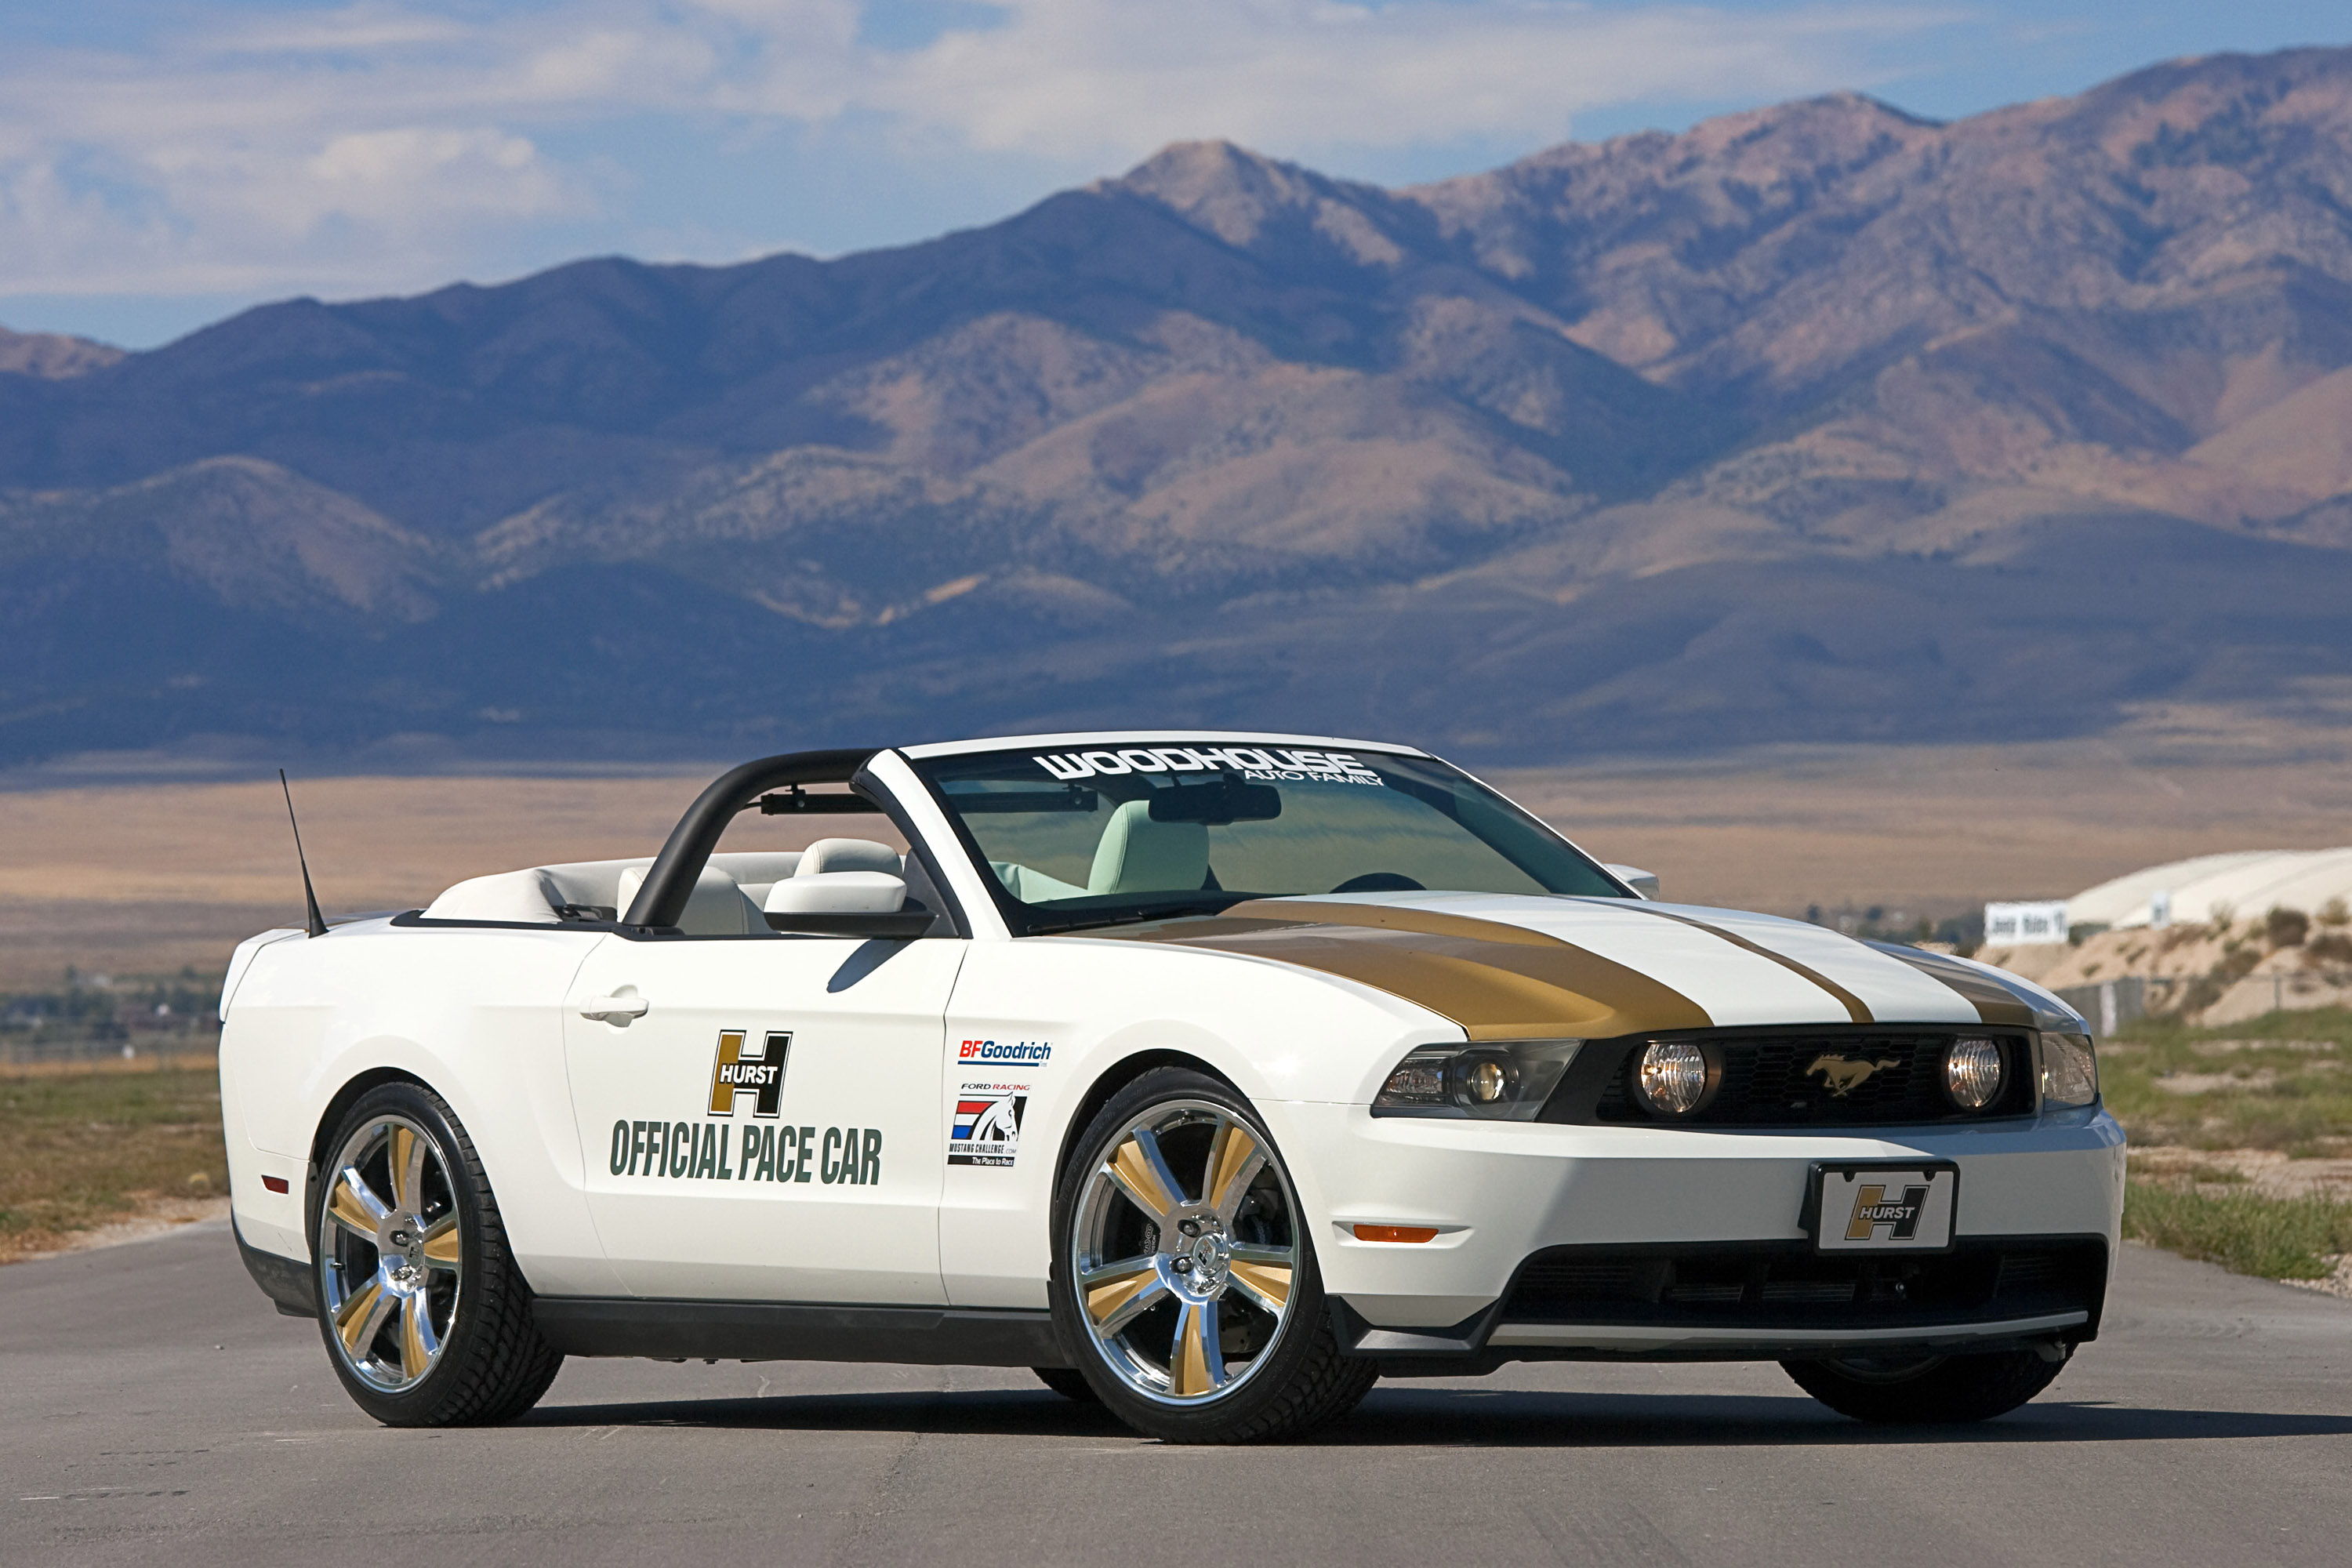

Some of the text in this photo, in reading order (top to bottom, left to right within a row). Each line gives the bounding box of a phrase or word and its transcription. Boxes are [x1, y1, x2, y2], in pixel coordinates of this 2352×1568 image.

[1033, 748, 1377, 780] WOODHOUSE
[1244, 769, 1385, 786] AUTO FAMILY
[960, 1040, 1051, 1060] BFGoodrich
[720, 1065, 778, 1084] HURST
[609, 1119, 882, 1185] OFFICIAL PACE CAR
[949, 1143, 975, 1153] MUSTANG
[982, 1156, 996, 1165] Place
[1860, 1207, 1915, 1219] HURST
